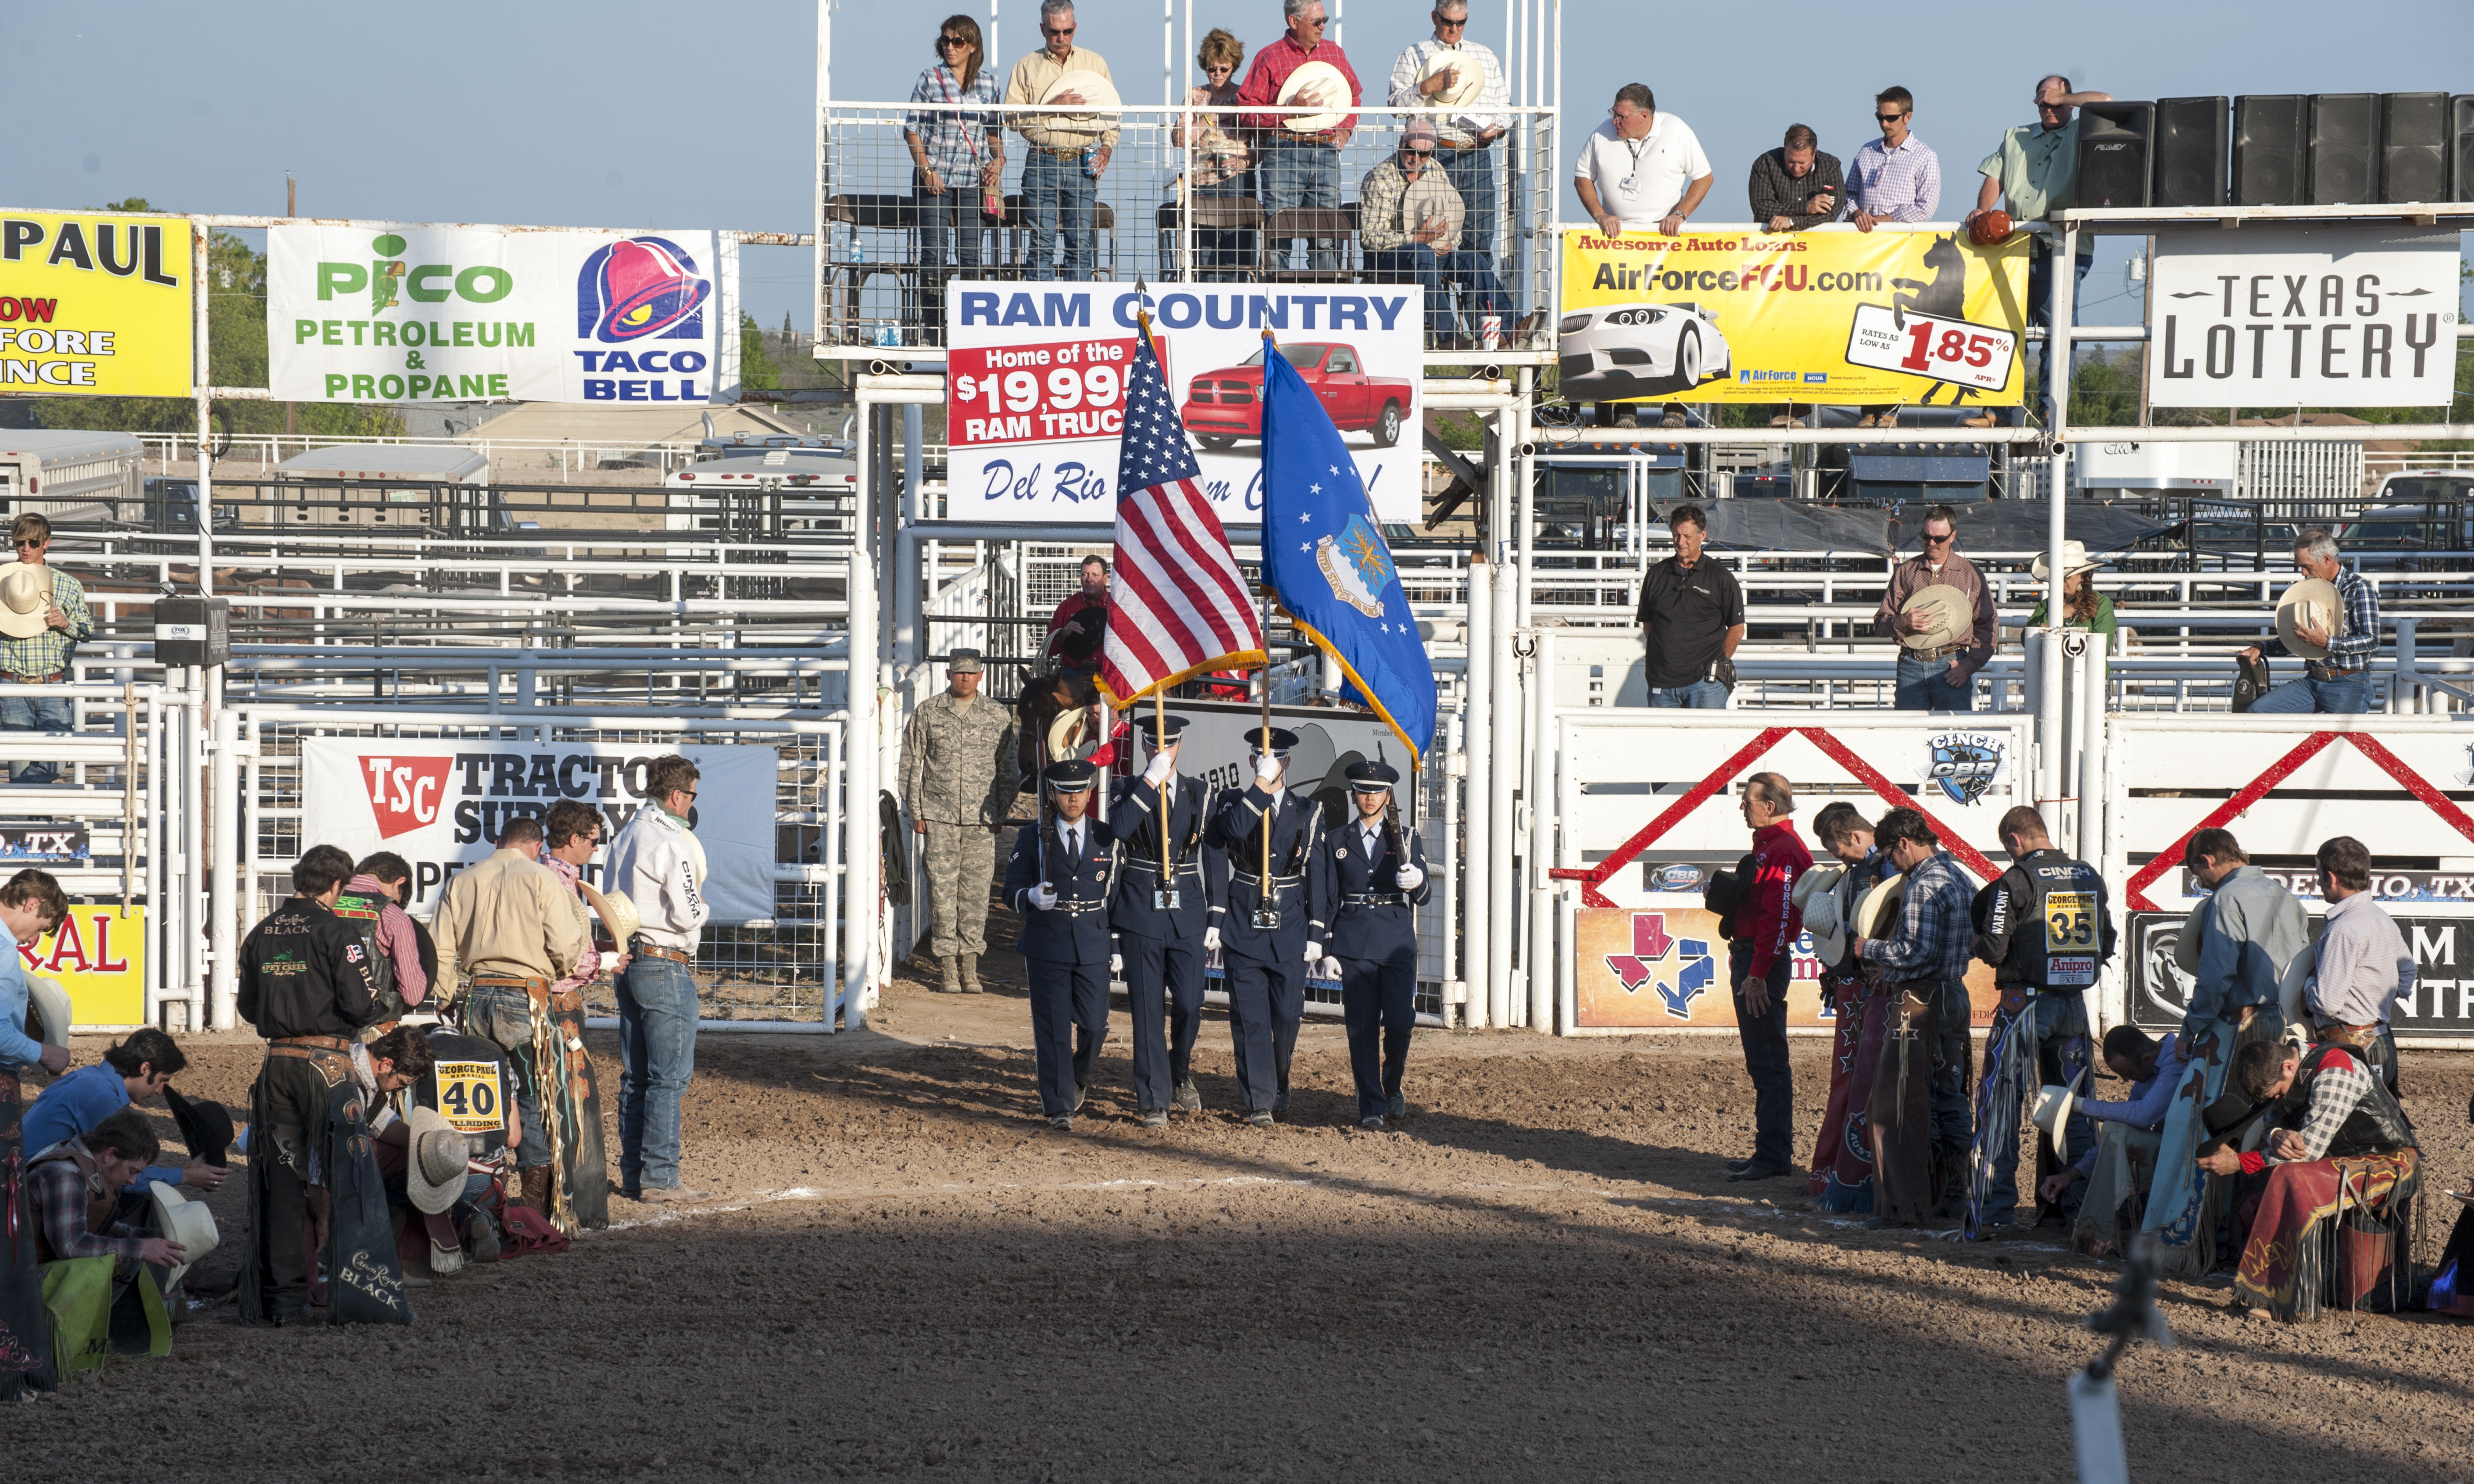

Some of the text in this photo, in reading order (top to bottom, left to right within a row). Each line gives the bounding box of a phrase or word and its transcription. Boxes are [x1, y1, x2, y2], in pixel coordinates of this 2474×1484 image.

[3, 220, 177, 287] PAUL
[1578, 235, 1807, 252] Awesome Auto Loans
[1592, 263, 1882, 291] AirForceFCU.com
[2217, 274, 2380, 317] TEXAS
[961, 292, 1408, 331] RAM COUNTRY
[295, 319, 535, 348] PETROLEUM
[1860, 339, 1879, 348] LOW
[1862, 329, 1887, 339] RATES
[986, 342, 1124, 369] Home of the
[2164, 313, 2437, 380] LOTTERY
[406, 350, 426, 370] &
[573, 351, 706, 373] TACO
[325, 374, 509, 399] PROPANE
[584, 379, 710, 401] BELL
[966, 409, 1124, 441] RAM TRUC
[2104, 442, 2129, 455] CM
[983, 459, 1106, 505] Del Rio
[1372, 728, 1394, 737] Member
[1932, 733, 2001, 752] CINCH
[456, 753, 695, 799] TRACTO
[1933, 761, 1997, 776] CBR
[369, 758, 435, 823] TSC
[25, 832, 76, 854] TX
[1666, 870, 1699, 879] CBR
[2038, 866, 2090, 877] CINCH
[2369, 875, 2419, 899] IO,
[1773, 865, 1792, 955] GEORGE PAUL
[1992, 889, 2009, 934] WAR PONY
[2048, 895, 2077, 904] GEORGE
[264, 925, 311, 935] BLACK
[2051, 912, 2093, 946] 35
[2050, 958, 2092, 973] Anipro
[439, 1065, 496, 1074] GEORGE PAUL
[442, 1081, 495, 1115] 40
[352, 1251, 403, 1290] Crown Royal
[339, 1267, 400, 1310] BLACK
